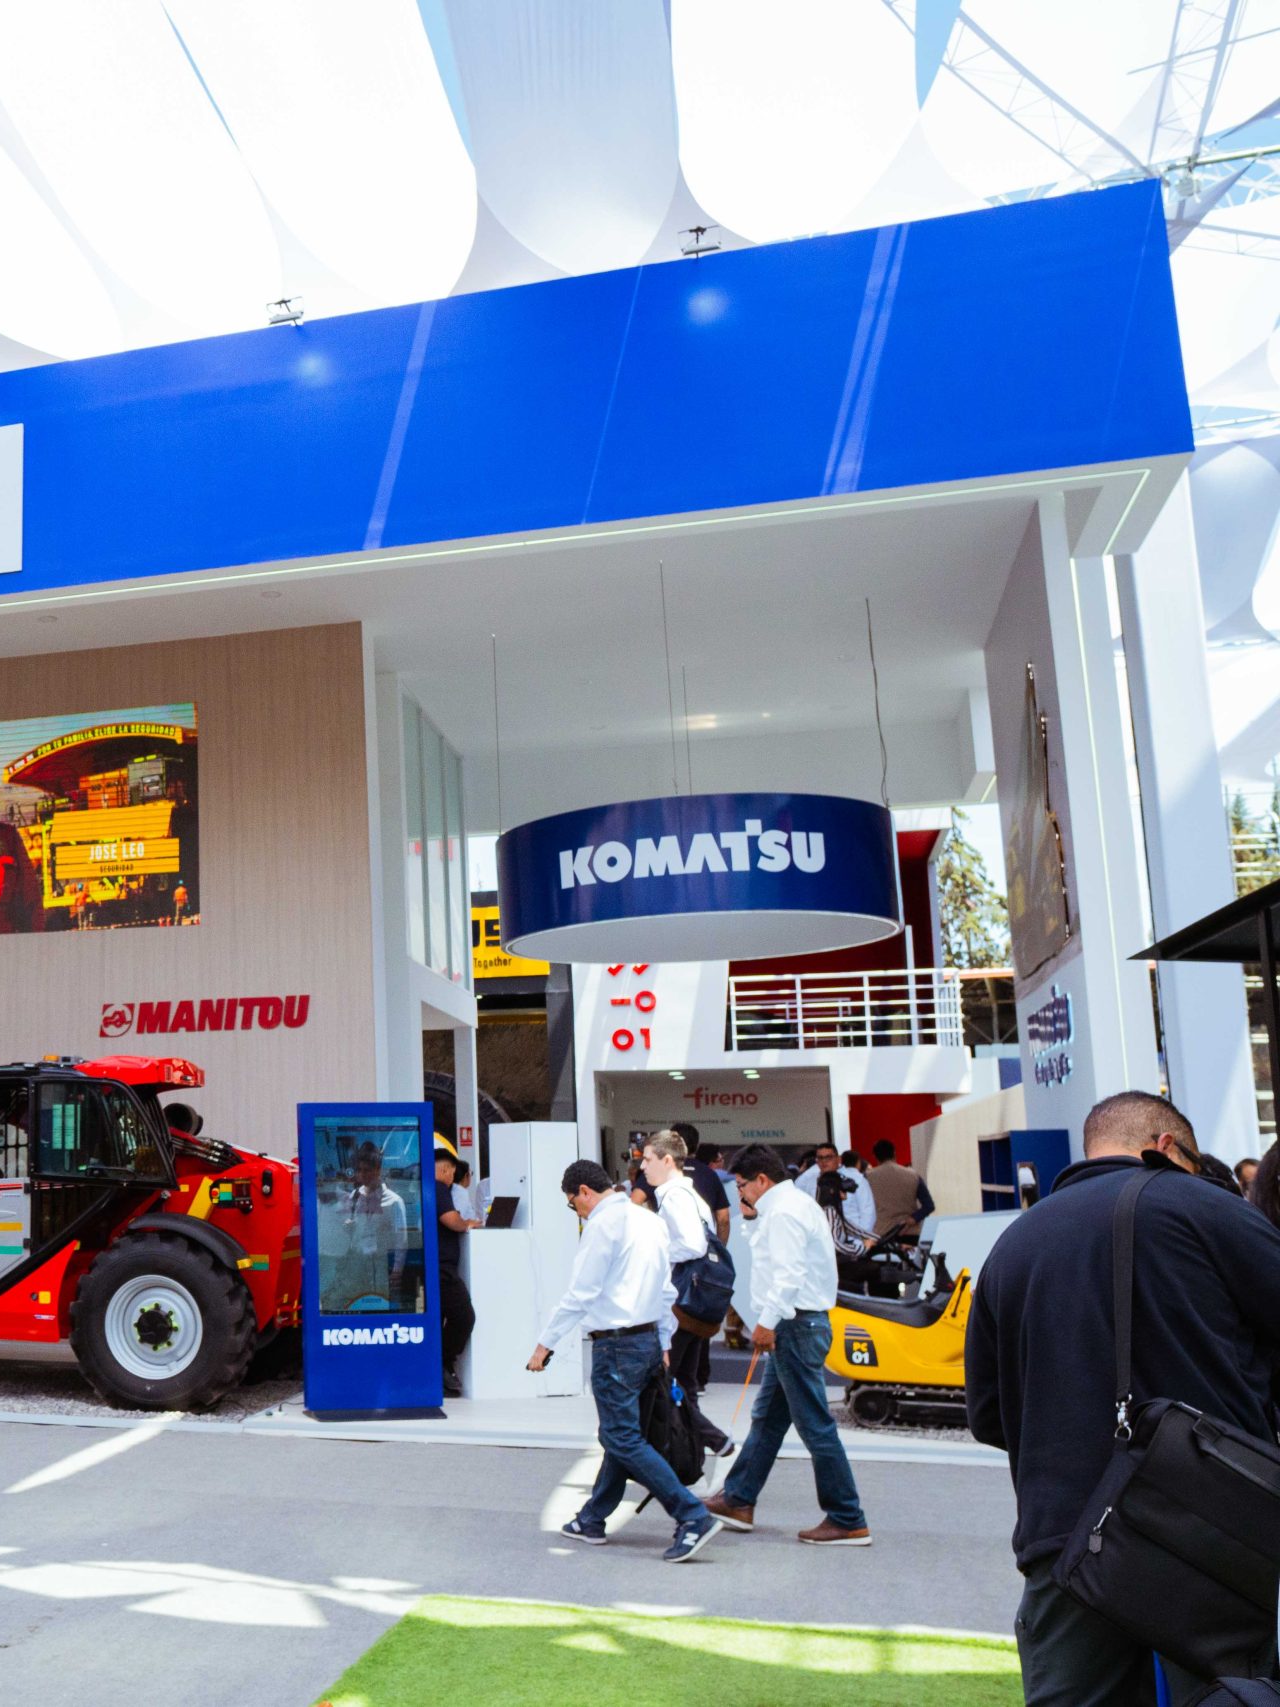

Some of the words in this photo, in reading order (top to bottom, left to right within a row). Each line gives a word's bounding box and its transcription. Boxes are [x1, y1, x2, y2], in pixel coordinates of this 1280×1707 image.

[122, 841, 145, 859] LEO
[558, 818, 826, 890] KOMATSU
[99, 863, 135, 874] SEGURIDAD
[473, 956, 512, 970] Together
[136, 994, 310, 1035] MANITOU
[683, 1086, 759, 1110] fireno
[741, 1129, 785, 1138] SIEMENS
[322, 1322, 425, 1346] KOMATSU
[852, 1341, 868, 1352] PC
[851, 1351, 870, 1364] 01
